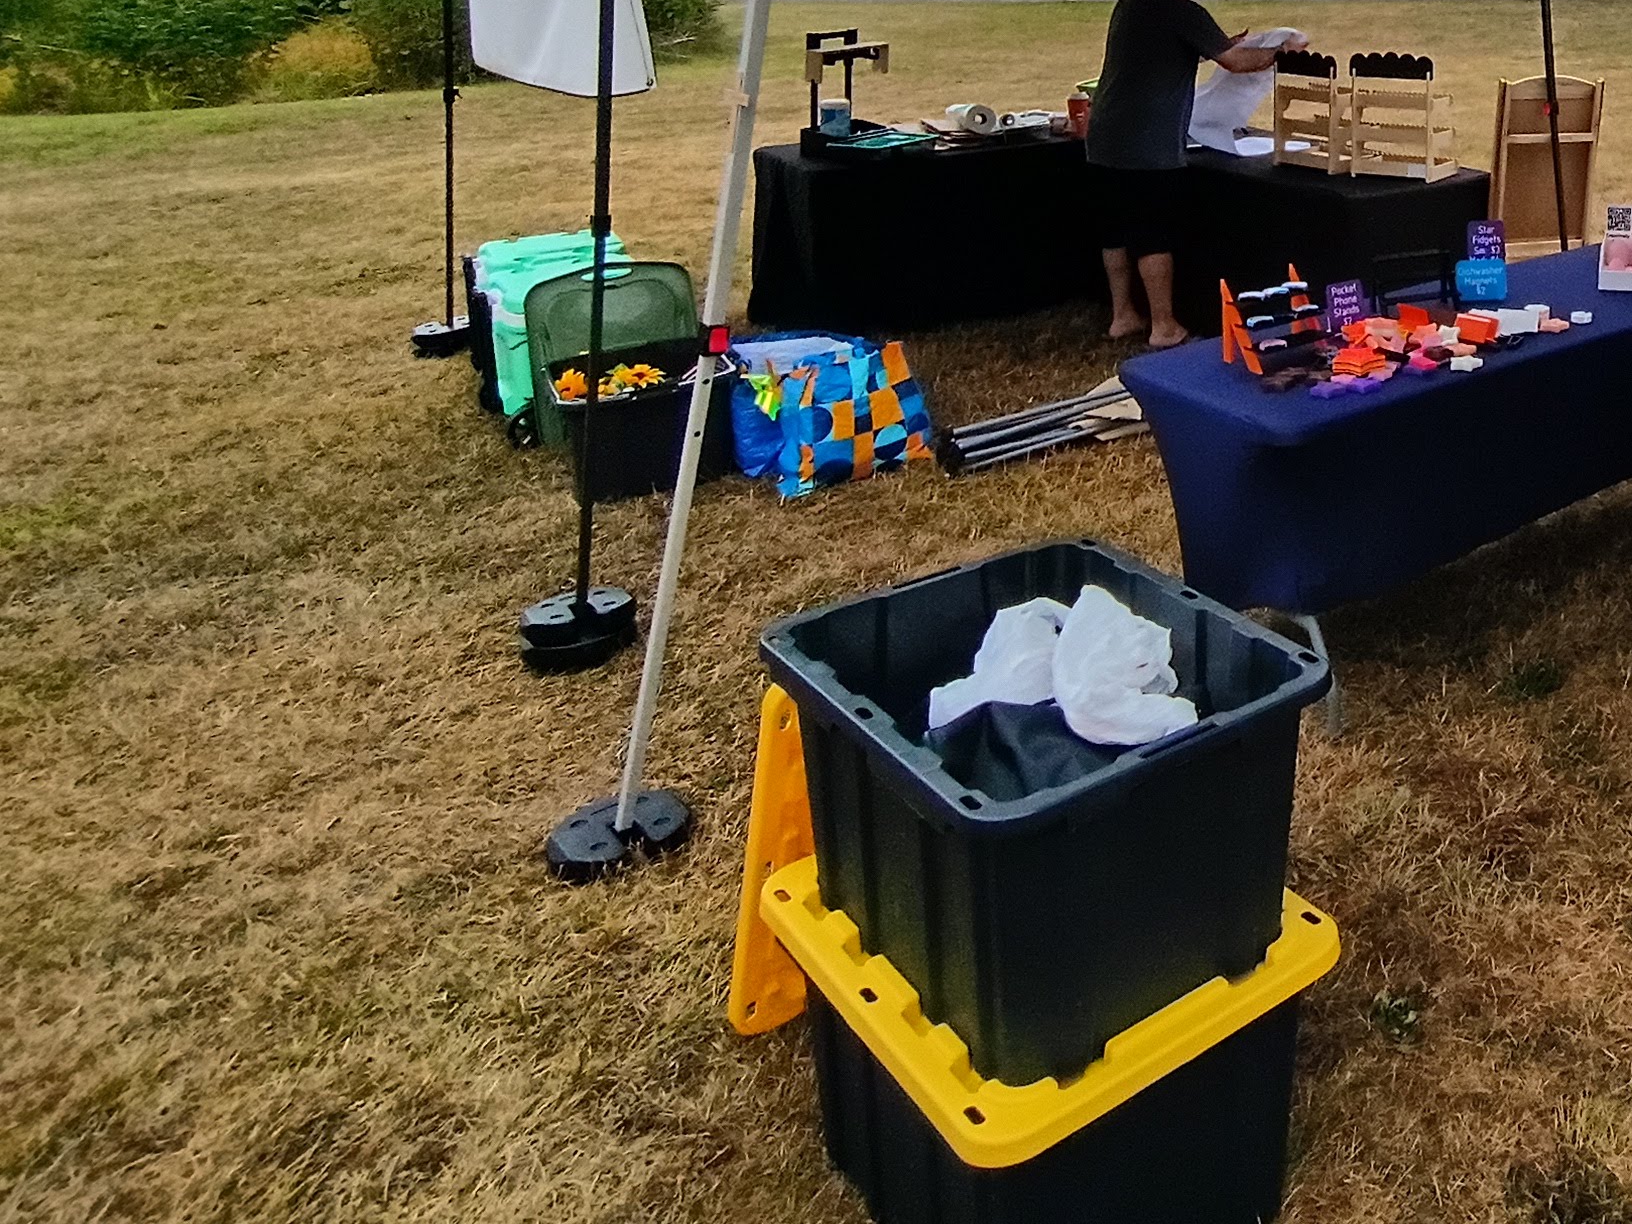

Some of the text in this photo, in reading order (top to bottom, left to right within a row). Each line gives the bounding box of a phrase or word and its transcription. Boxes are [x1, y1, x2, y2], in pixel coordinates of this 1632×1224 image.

[1477, 225, 1495, 234] Star
[1472, 235, 1502, 246] Fidgets
[1458, 266, 1504, 276] Dishwasher
[1331, 283, 1357, 296] Pocket
[1333, 295, 1358, 307] Phone
[1333, 305, 1360, 317] Stands
